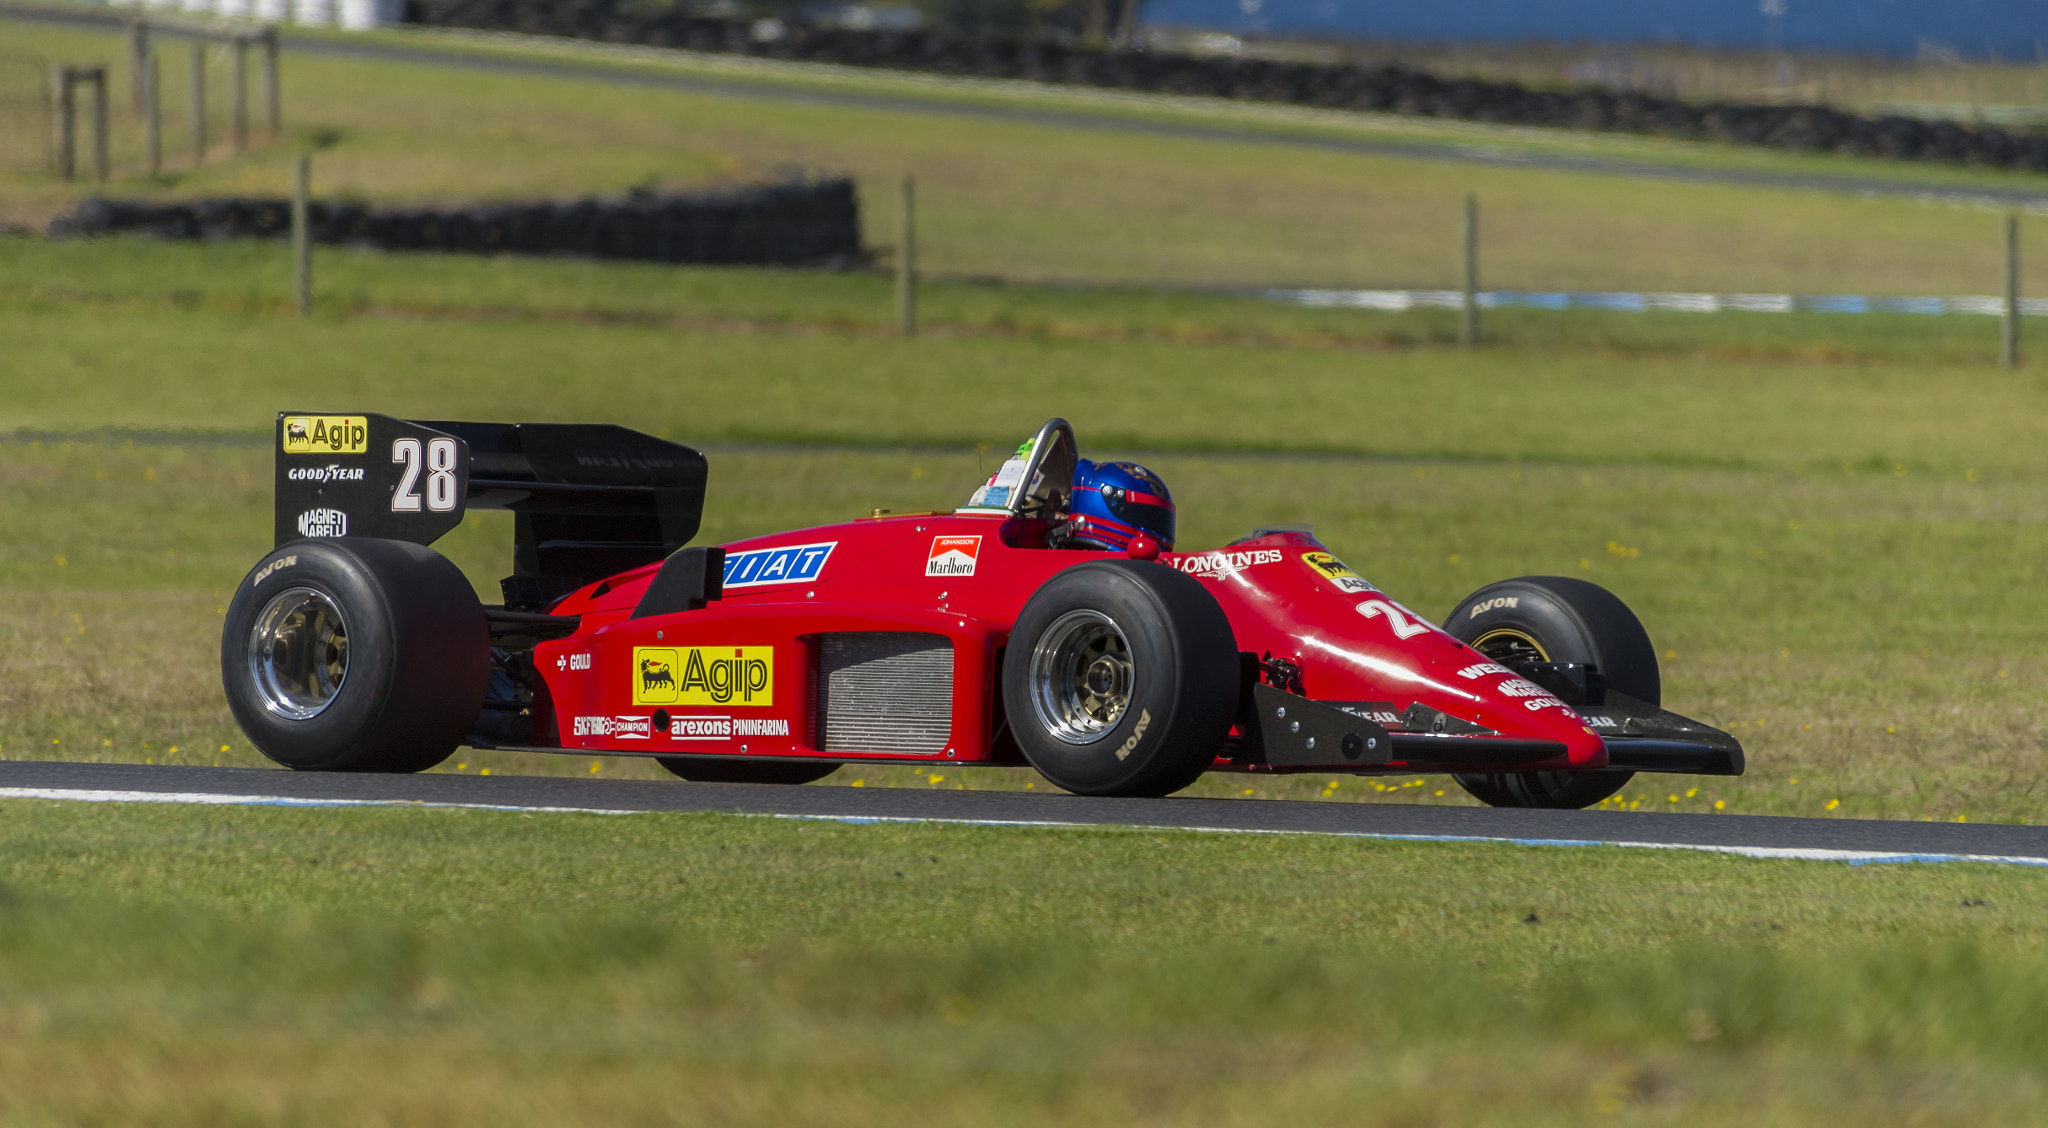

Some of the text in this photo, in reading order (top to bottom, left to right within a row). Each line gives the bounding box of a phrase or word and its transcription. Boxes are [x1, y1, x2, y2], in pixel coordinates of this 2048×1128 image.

[311, 419, 365, 450] Agip
[392, 437, 457, 512] 28
[298, 508, 347, 526] MAGNETI
[940, 538, 975, 546] JOHANSSON
[253, 555, 298, 588] AVON
[928, 557, 973, 574] Marlboro
[1173, 549, 1283, 573] LONGINES
[1470, 597, 1519, 620] AVON
[1356, 599, 1447, 640] 2
[570, 653, 591, 671] GOULD
[680, 648, 768, 703] Agip
[573, 716, 590, 736] SKF
[616, 721, 648, 732] CHAMPION
[671, 720, 732, 735] arexons
[733, 719, 789, 736] PININFARINA
[1115, 708, 1151, 762] AVON
